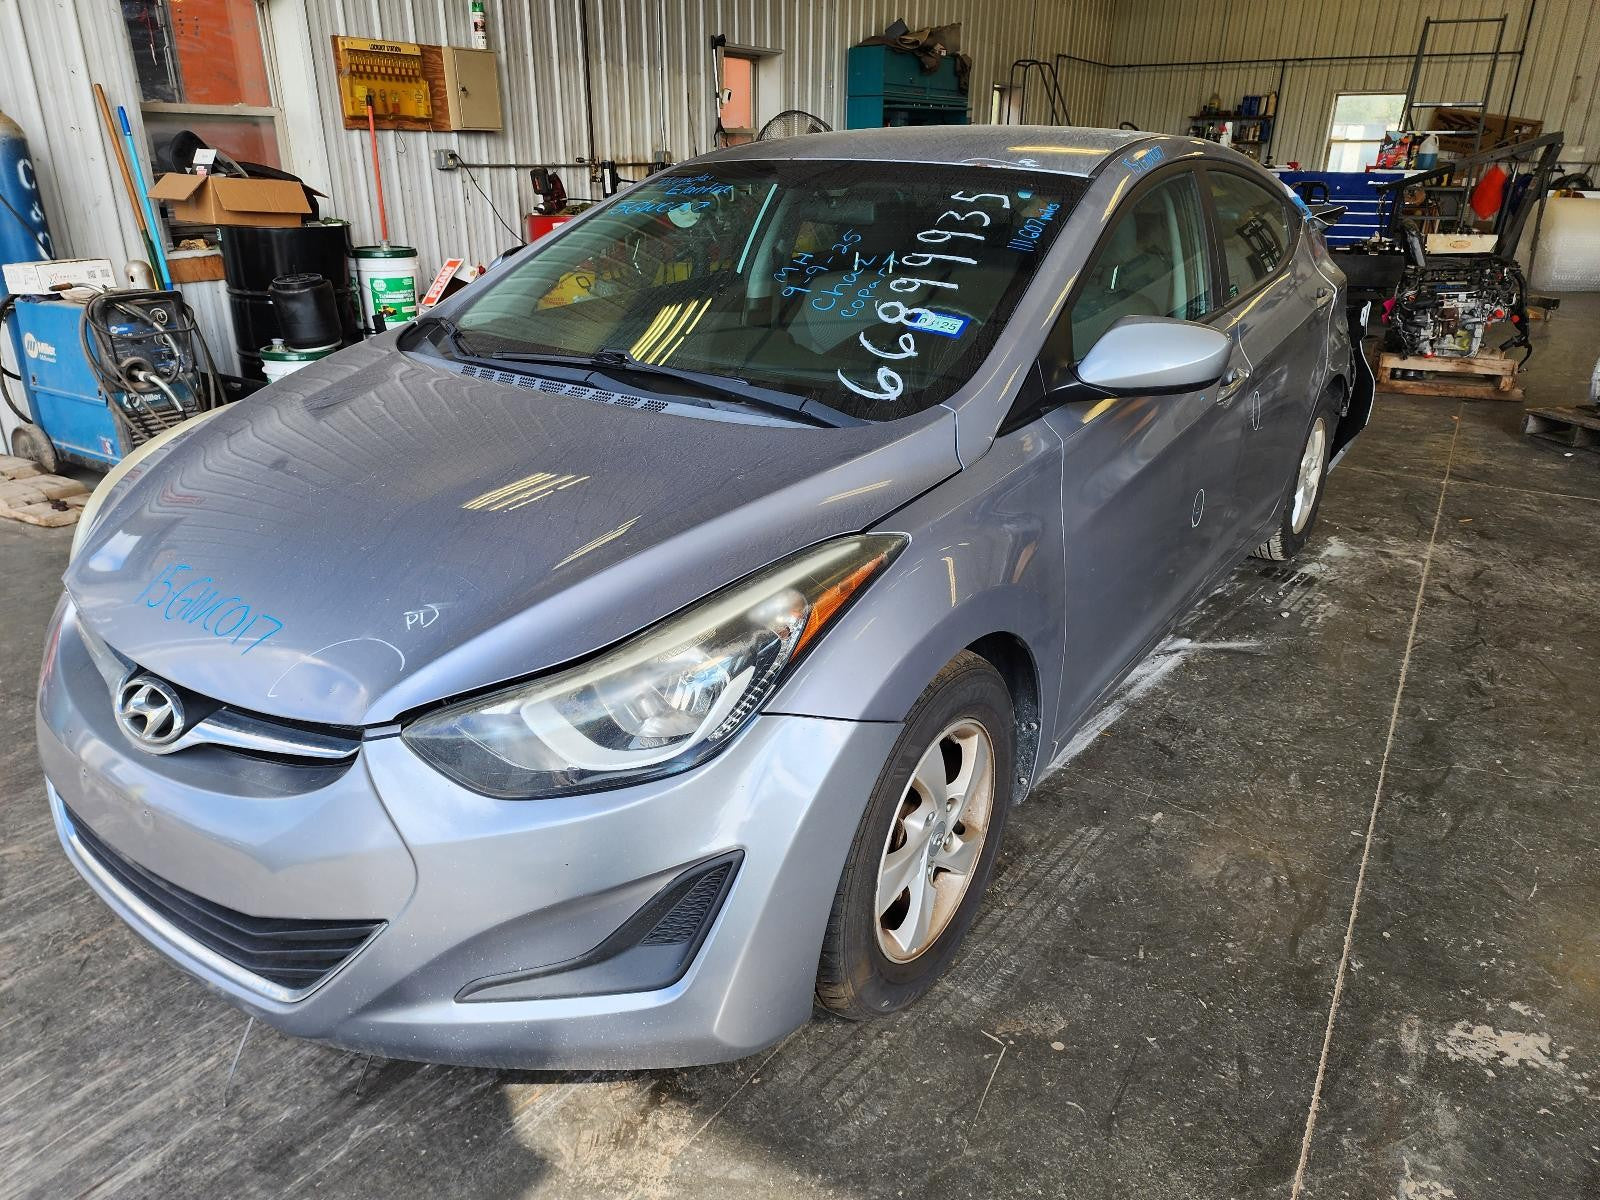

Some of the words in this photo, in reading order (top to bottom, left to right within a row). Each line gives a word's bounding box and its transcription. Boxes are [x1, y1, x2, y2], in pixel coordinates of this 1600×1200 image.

[429, 264, 456, 298] FRAM
[837, 190, 1011, 402] 66899935
[940, 321, 957, 331] 25
